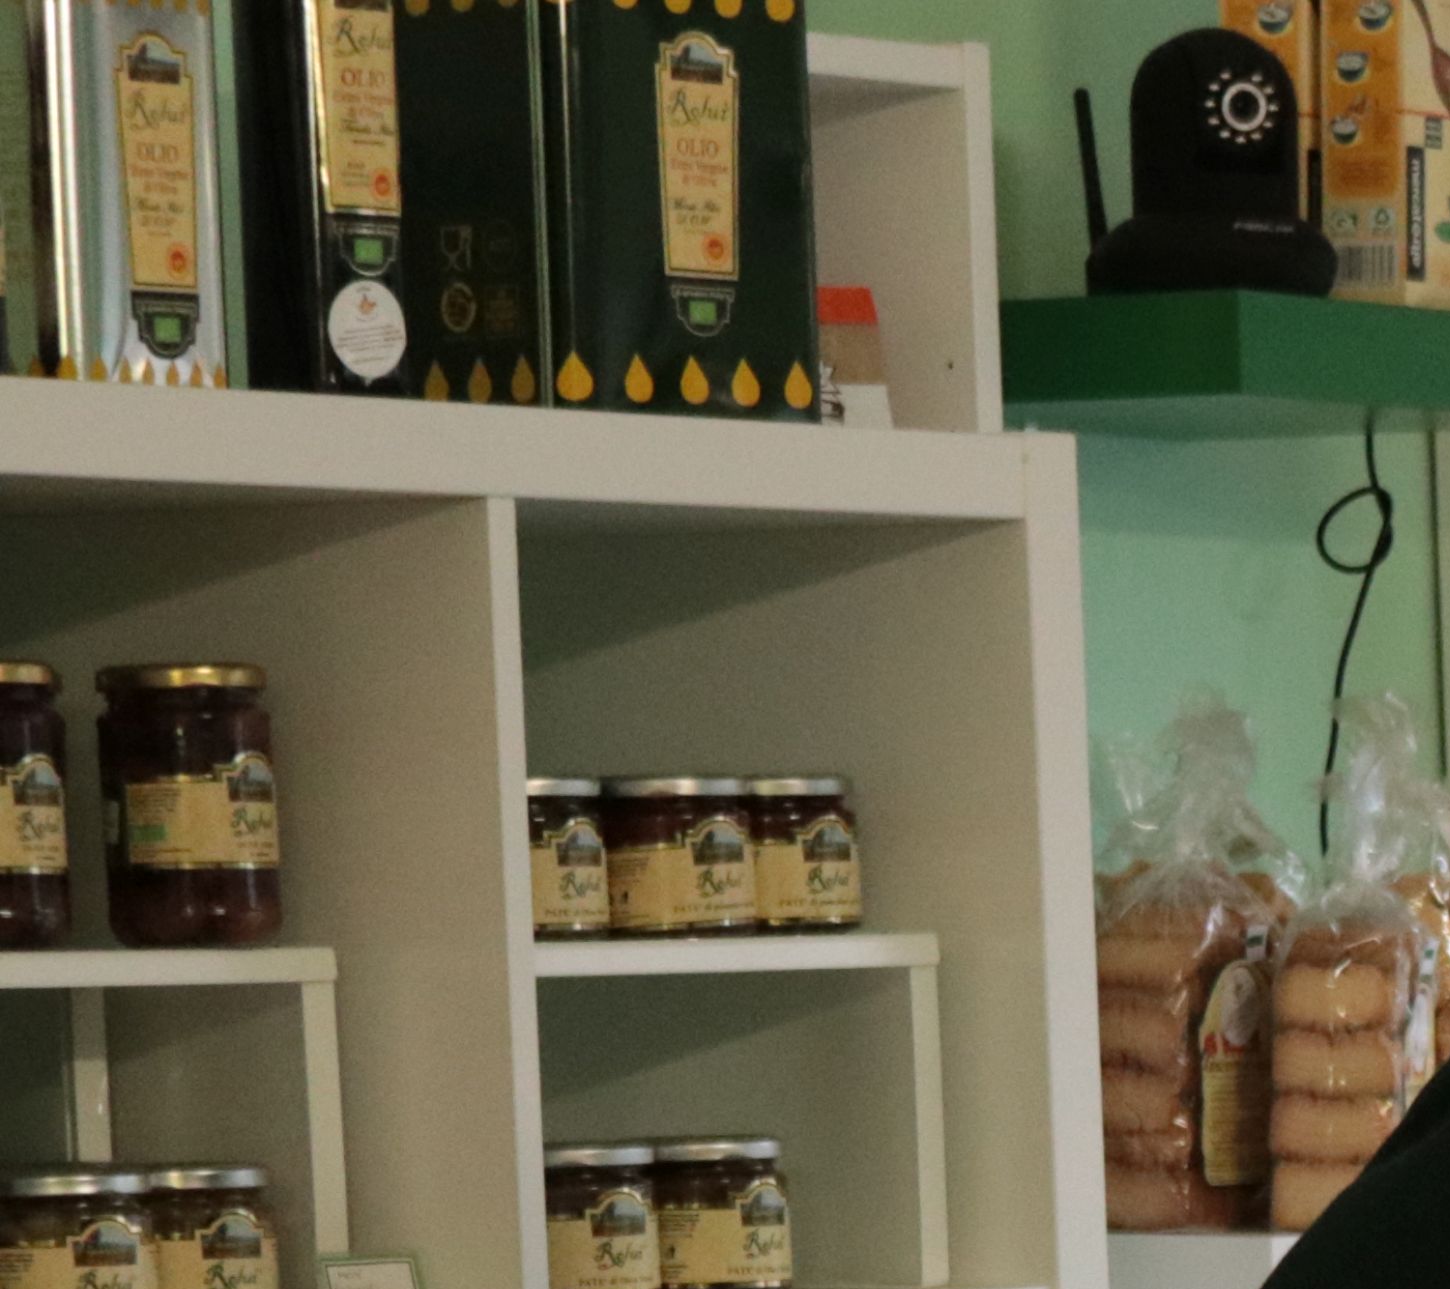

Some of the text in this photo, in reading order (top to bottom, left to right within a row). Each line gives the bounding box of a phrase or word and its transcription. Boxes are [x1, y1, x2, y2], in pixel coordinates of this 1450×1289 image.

[341, 68, 385, 88] OLIO
[136, 143, 178, 162] OLIO
[677, 138, 718, 158] OLIO
